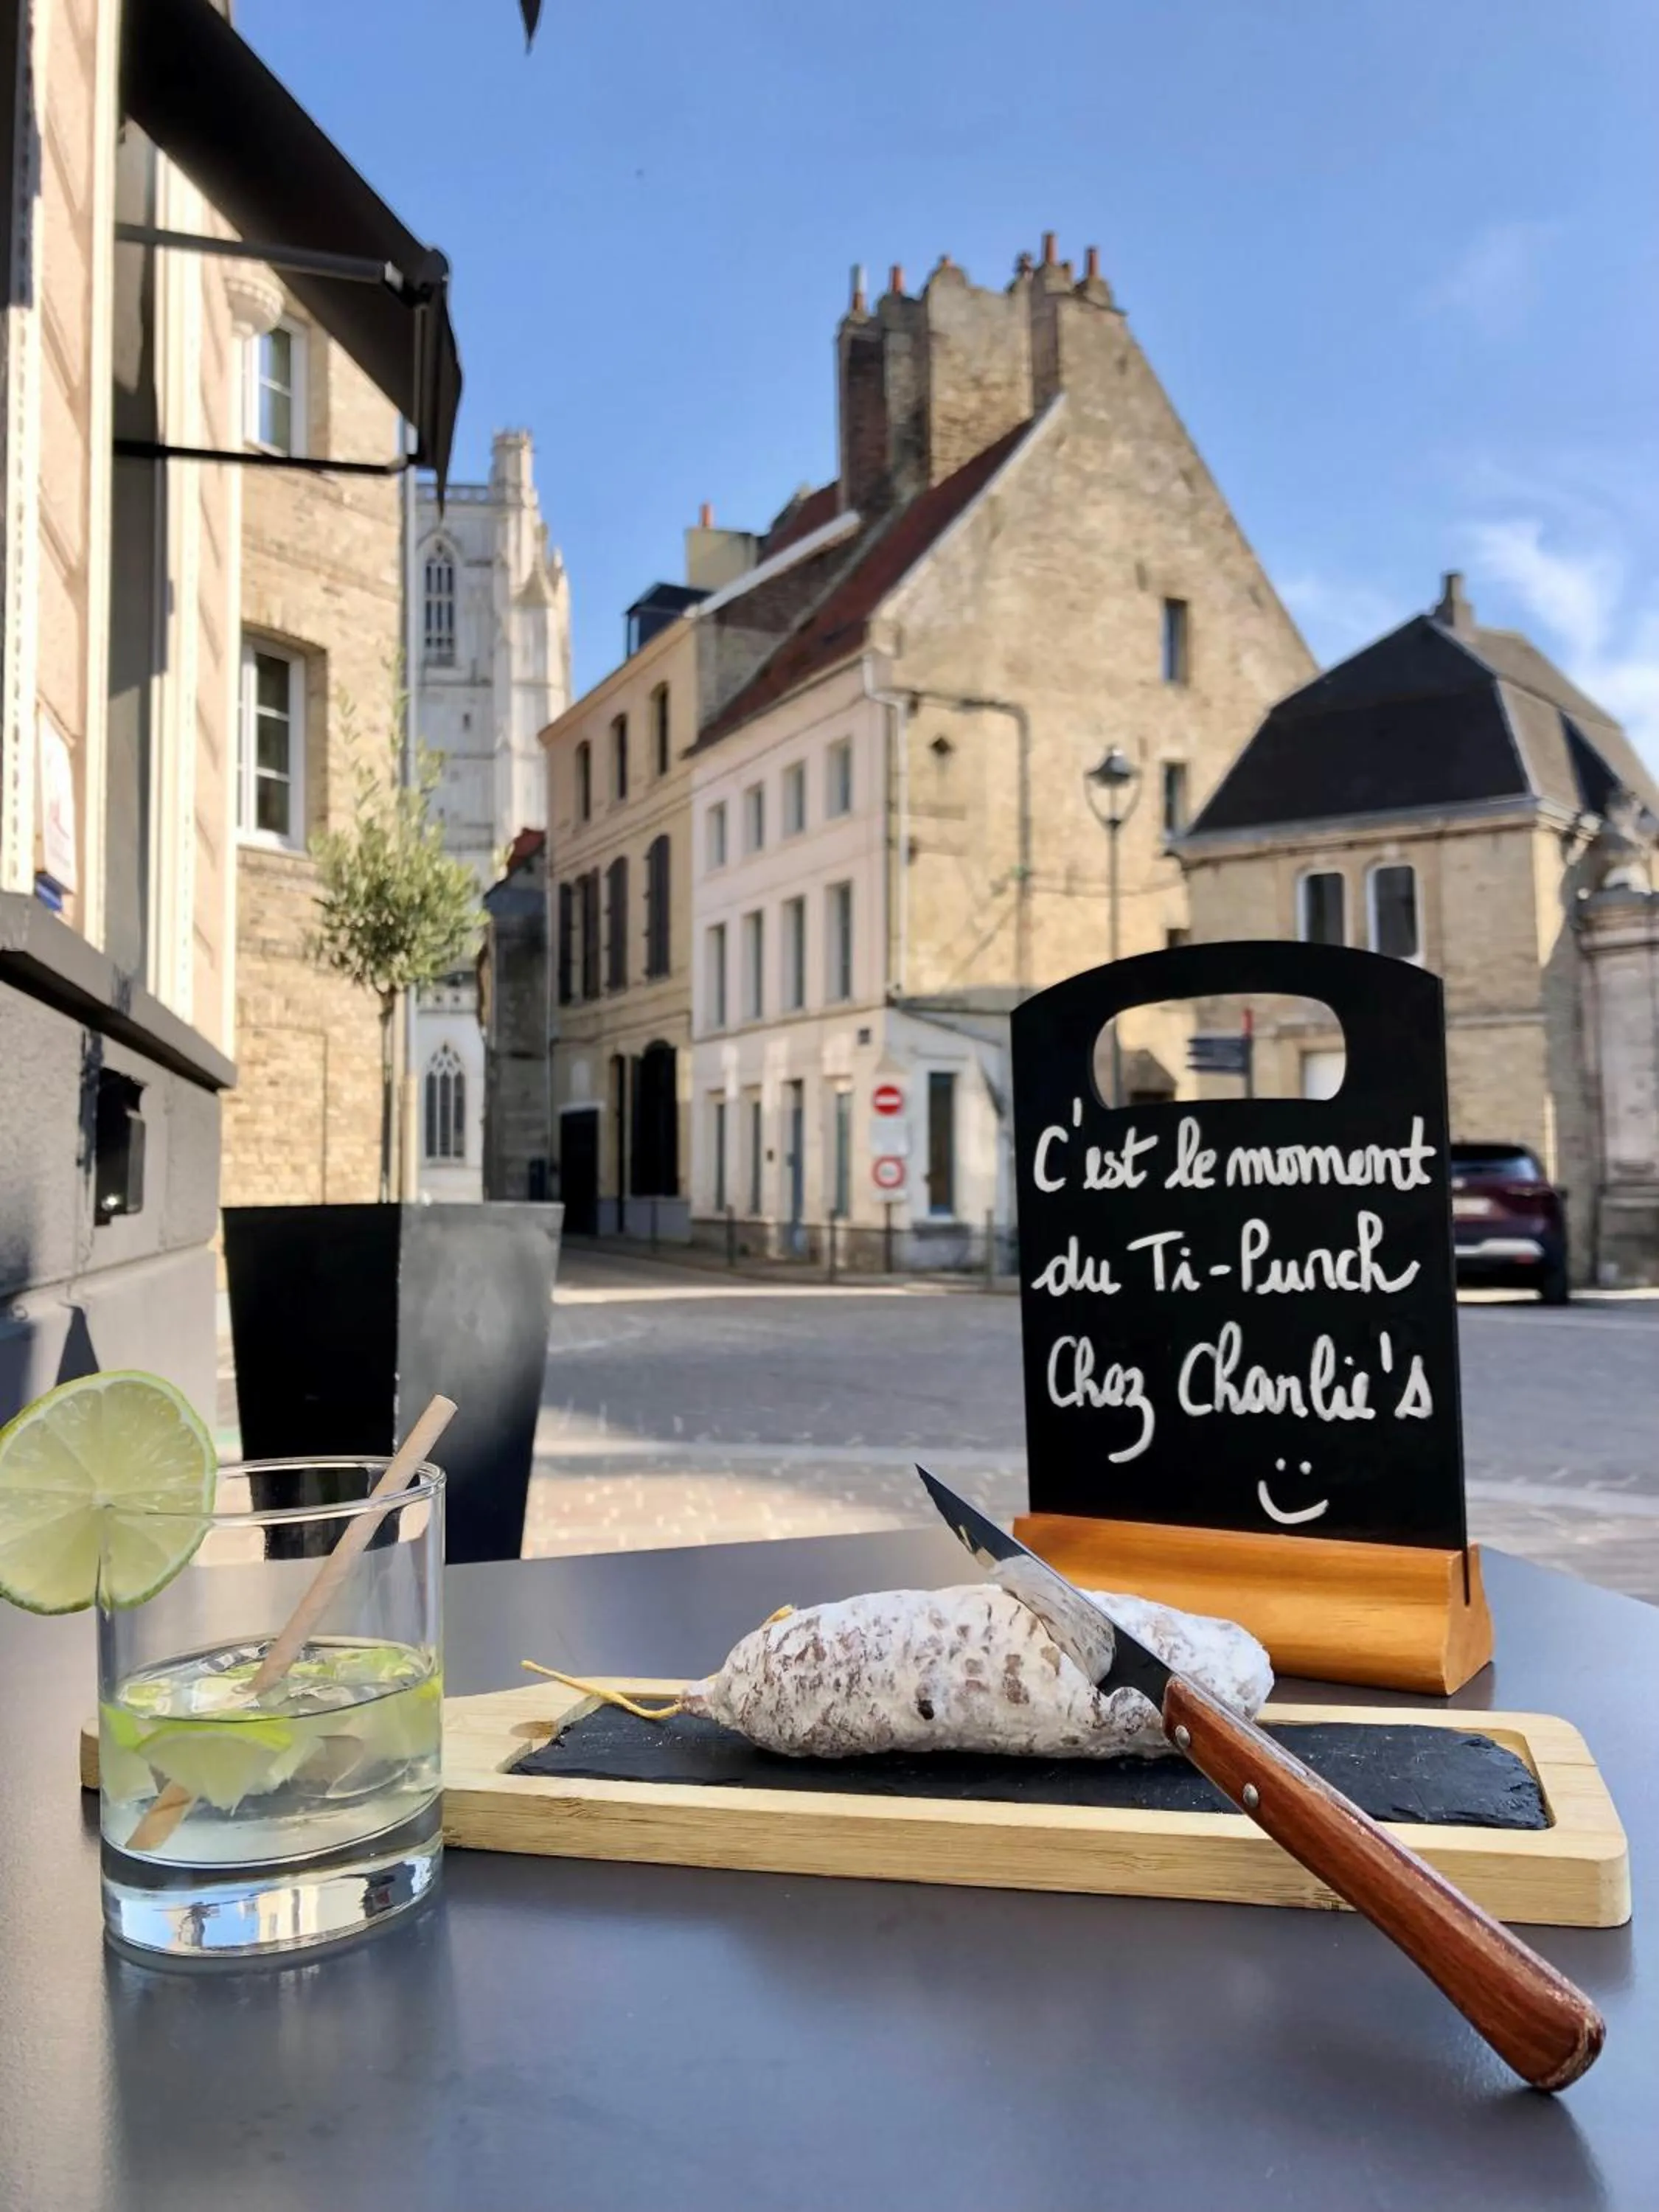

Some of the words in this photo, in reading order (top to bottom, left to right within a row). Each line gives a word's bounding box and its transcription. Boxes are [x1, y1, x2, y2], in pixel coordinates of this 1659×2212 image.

[1033, 1097, 1158, 1193] C'est
[1164, 1116, 1217, 1189] le
[1226, 1116, 1437, 1191] moment
[1032, 1236, 1121, 1297] du
[1047, 1335, 1155, 1464] Chez
[1178, 1321, 1433, 1422] Charlie's
